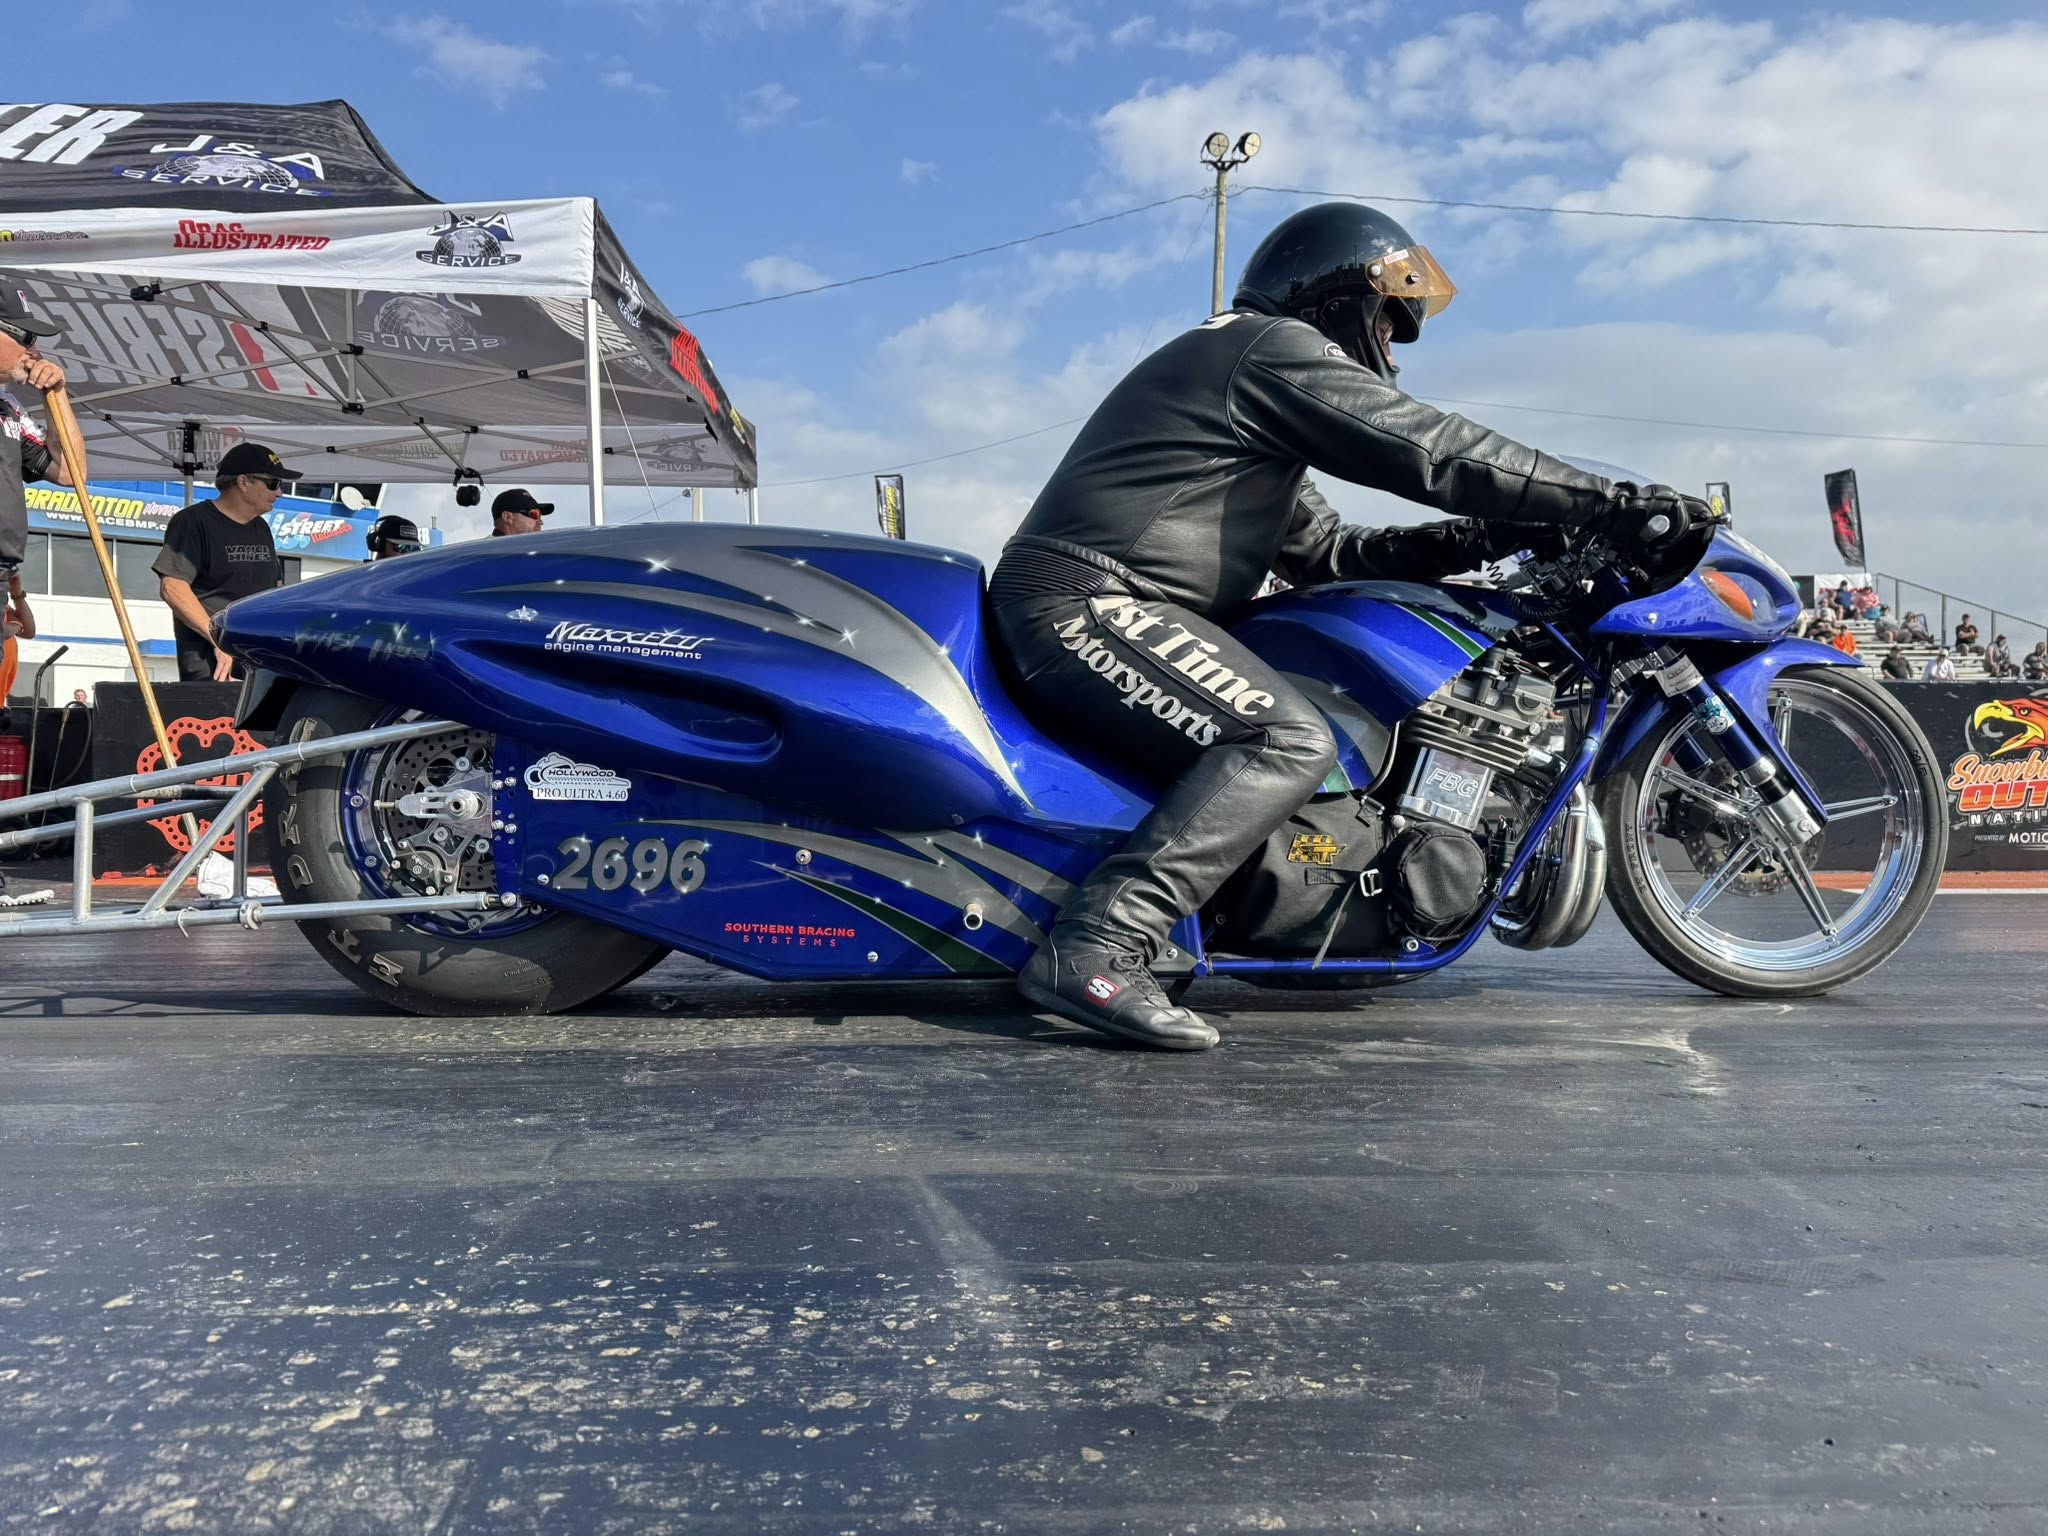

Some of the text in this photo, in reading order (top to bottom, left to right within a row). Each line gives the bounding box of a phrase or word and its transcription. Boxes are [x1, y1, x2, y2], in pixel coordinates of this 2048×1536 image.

[150, 135, 326, 181] J&A
[121, 169, 324, 197] SERVICE
[427, 210, 514, 241] J&A
[173, 232, 330, 250] ILLUSTRATED
[421, 252, 517, 267] SERVICE
[617, 297, 641, 329] SERVICE
[278, 519, 345, 537] STREET
[546, 621, 715, 650] MaxxECU
[544, 641, 702, 660] engine management
[1148, 622, 1276, 716] Time
[548, 769, 614, 777] HOLLYWOOD
[1425, 767, 1480, 799] FBG
[537, 788, 627, 800] PRO ULTRA 4.60
[552, 837, 708, 893] 2696
[724, 922, 856, 938] SOUTHERN BRACING
[743, 935, 838, 947] SYSTEMS
